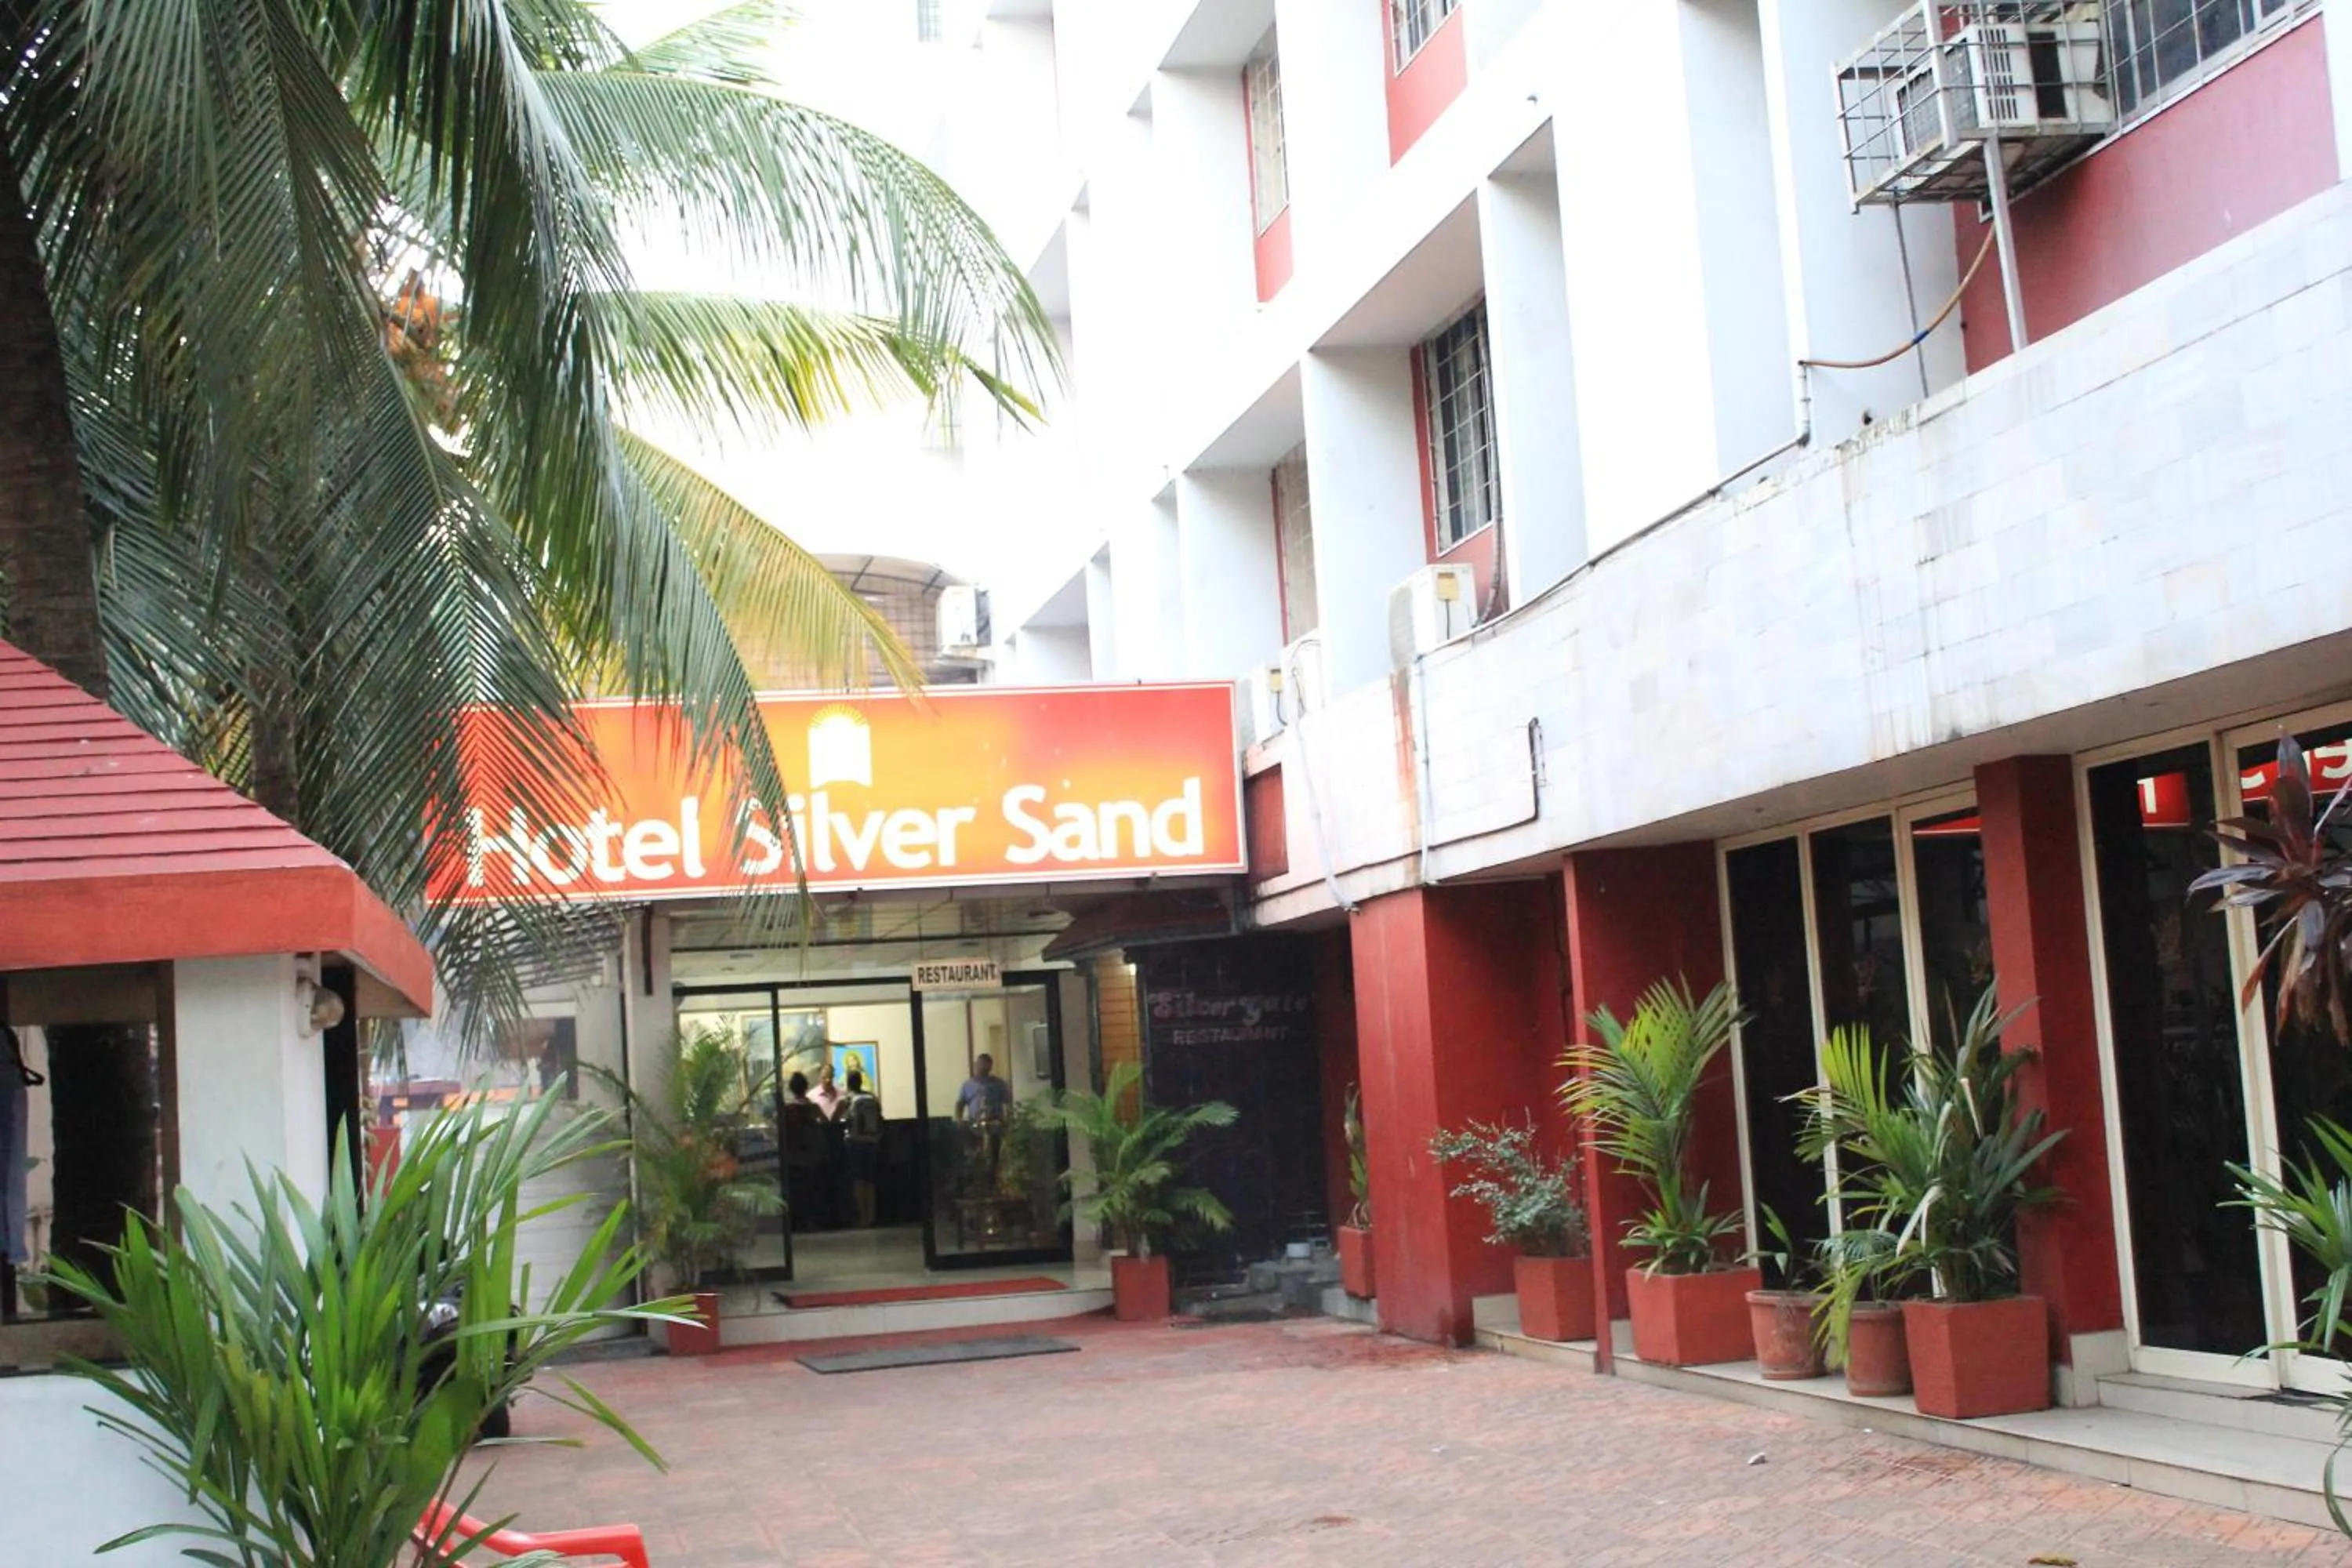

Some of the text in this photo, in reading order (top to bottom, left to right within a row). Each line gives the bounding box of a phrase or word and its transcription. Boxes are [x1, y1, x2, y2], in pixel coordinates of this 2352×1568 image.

[466, 776, 1205, 887] Hotel Silver Sand
[916, 963, 996, 985] RESTAURANT
